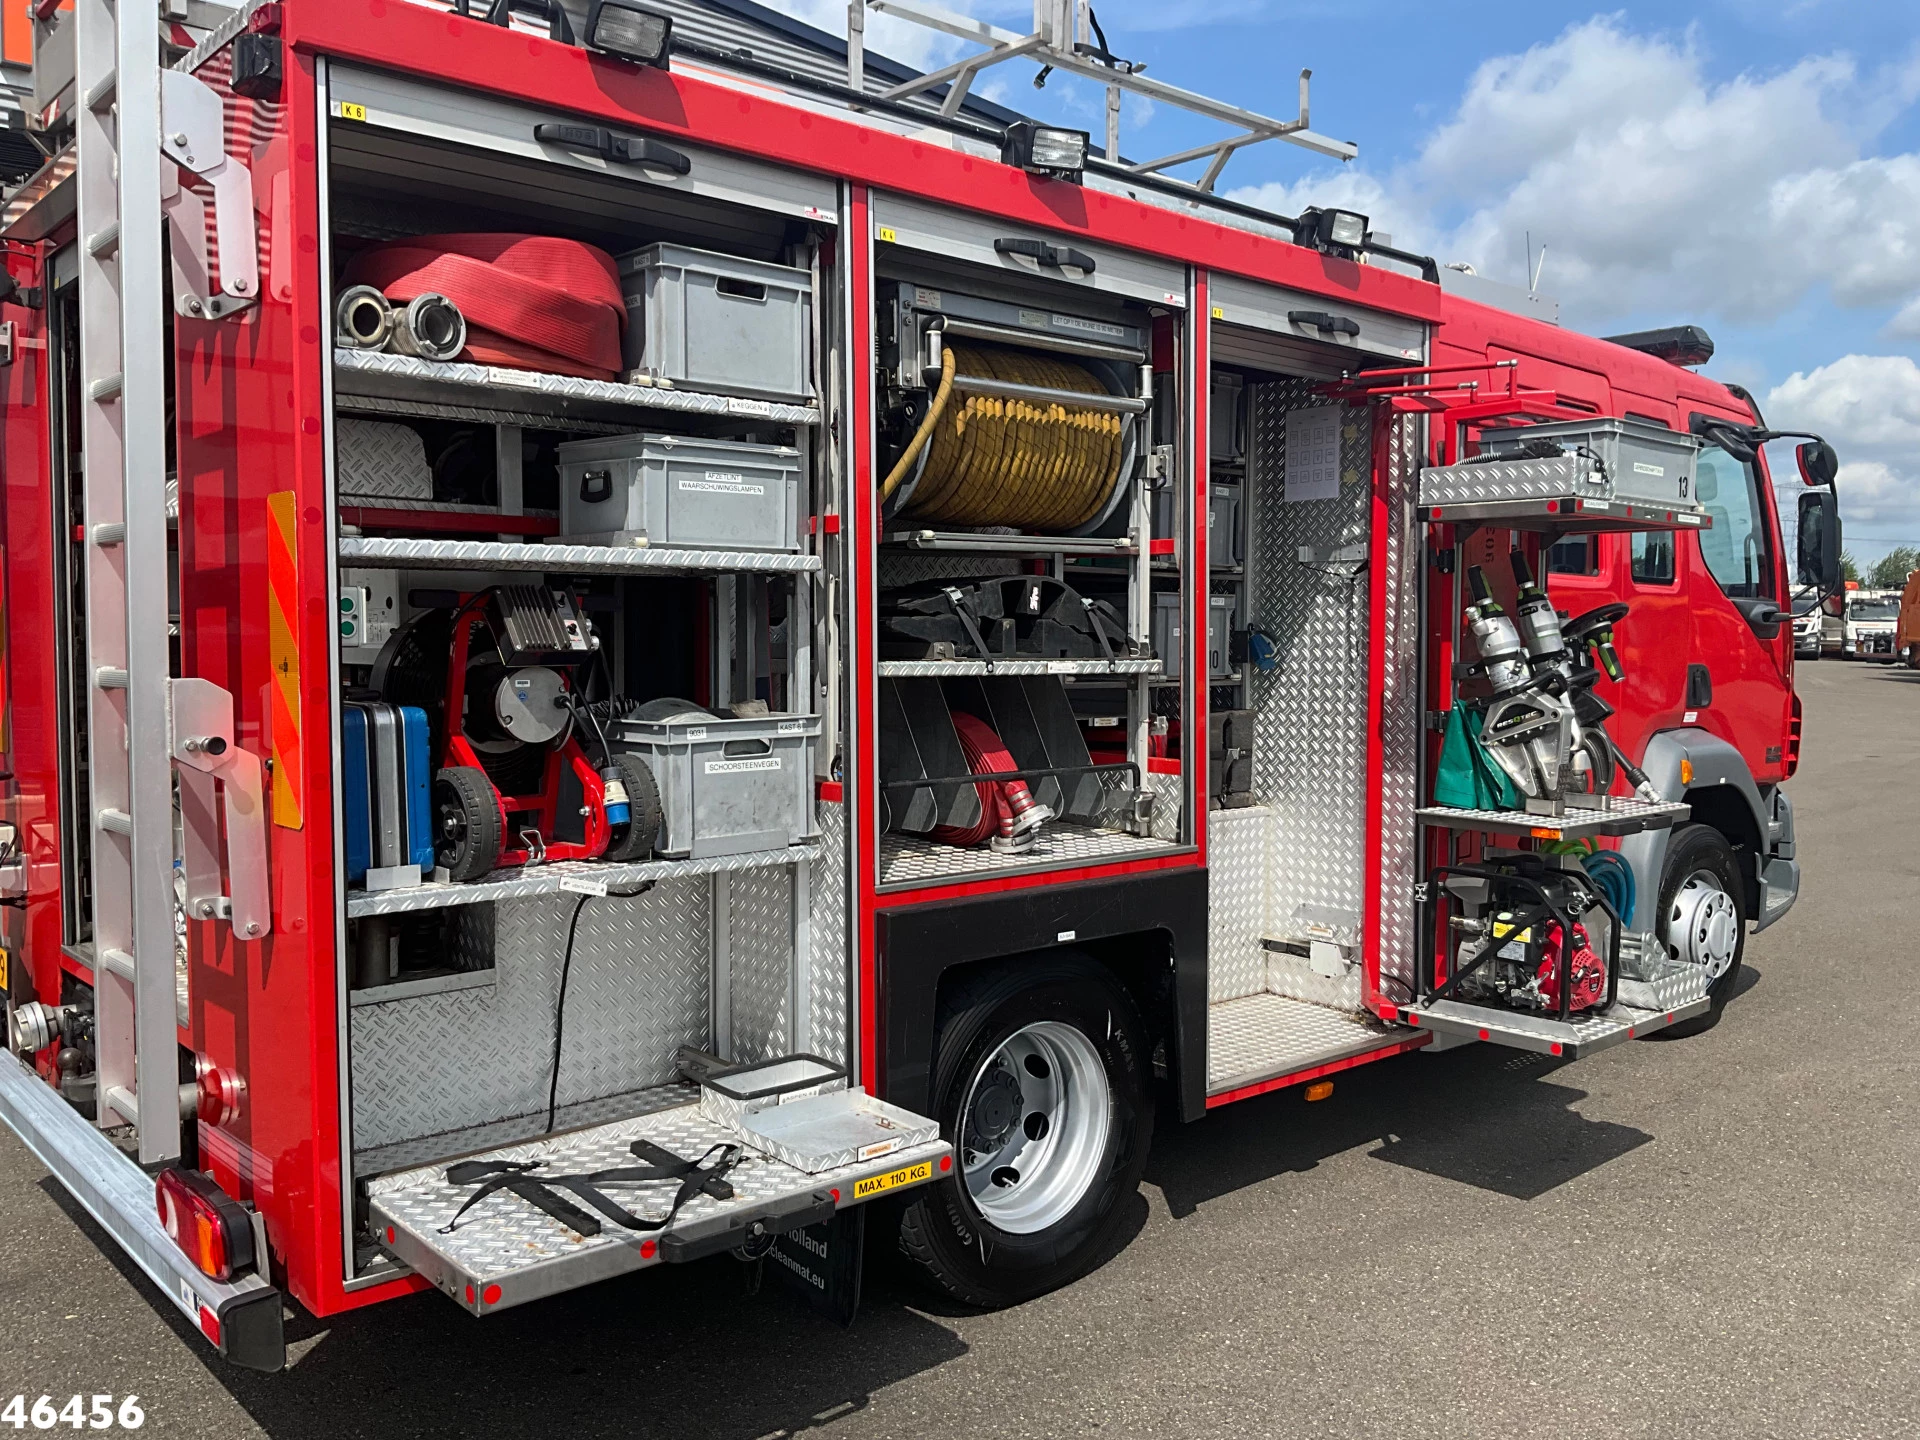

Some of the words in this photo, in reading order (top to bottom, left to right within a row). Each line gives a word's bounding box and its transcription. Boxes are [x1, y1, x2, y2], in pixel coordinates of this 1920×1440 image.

[345, 104, 352, 116] K
[356, 107, 362, 118] 6
[882, 230, 887, 239] K
[736, 402, 763, 411] KEGGEN
[707, 472, 740, 481] AFZETLINT
[681, 482, 762, 493] WAARSCHUWINGSLAMPEN
[1678, 476, 1688, 498] 13
[1496, 710, 1538, 728] RESQTEC
[779, 723, 796, 731] KAST
[688, 729, 705, 737] 9031
[709, 760, 780, 771] SCHOORSTEENVEGEN
[858, 1178, 885, 1195] MAX.
[890, 1171, 906, 1185] 110
[910, 1166, 928, 1180] KG.
[784, 1227, 828, 1259] olland
